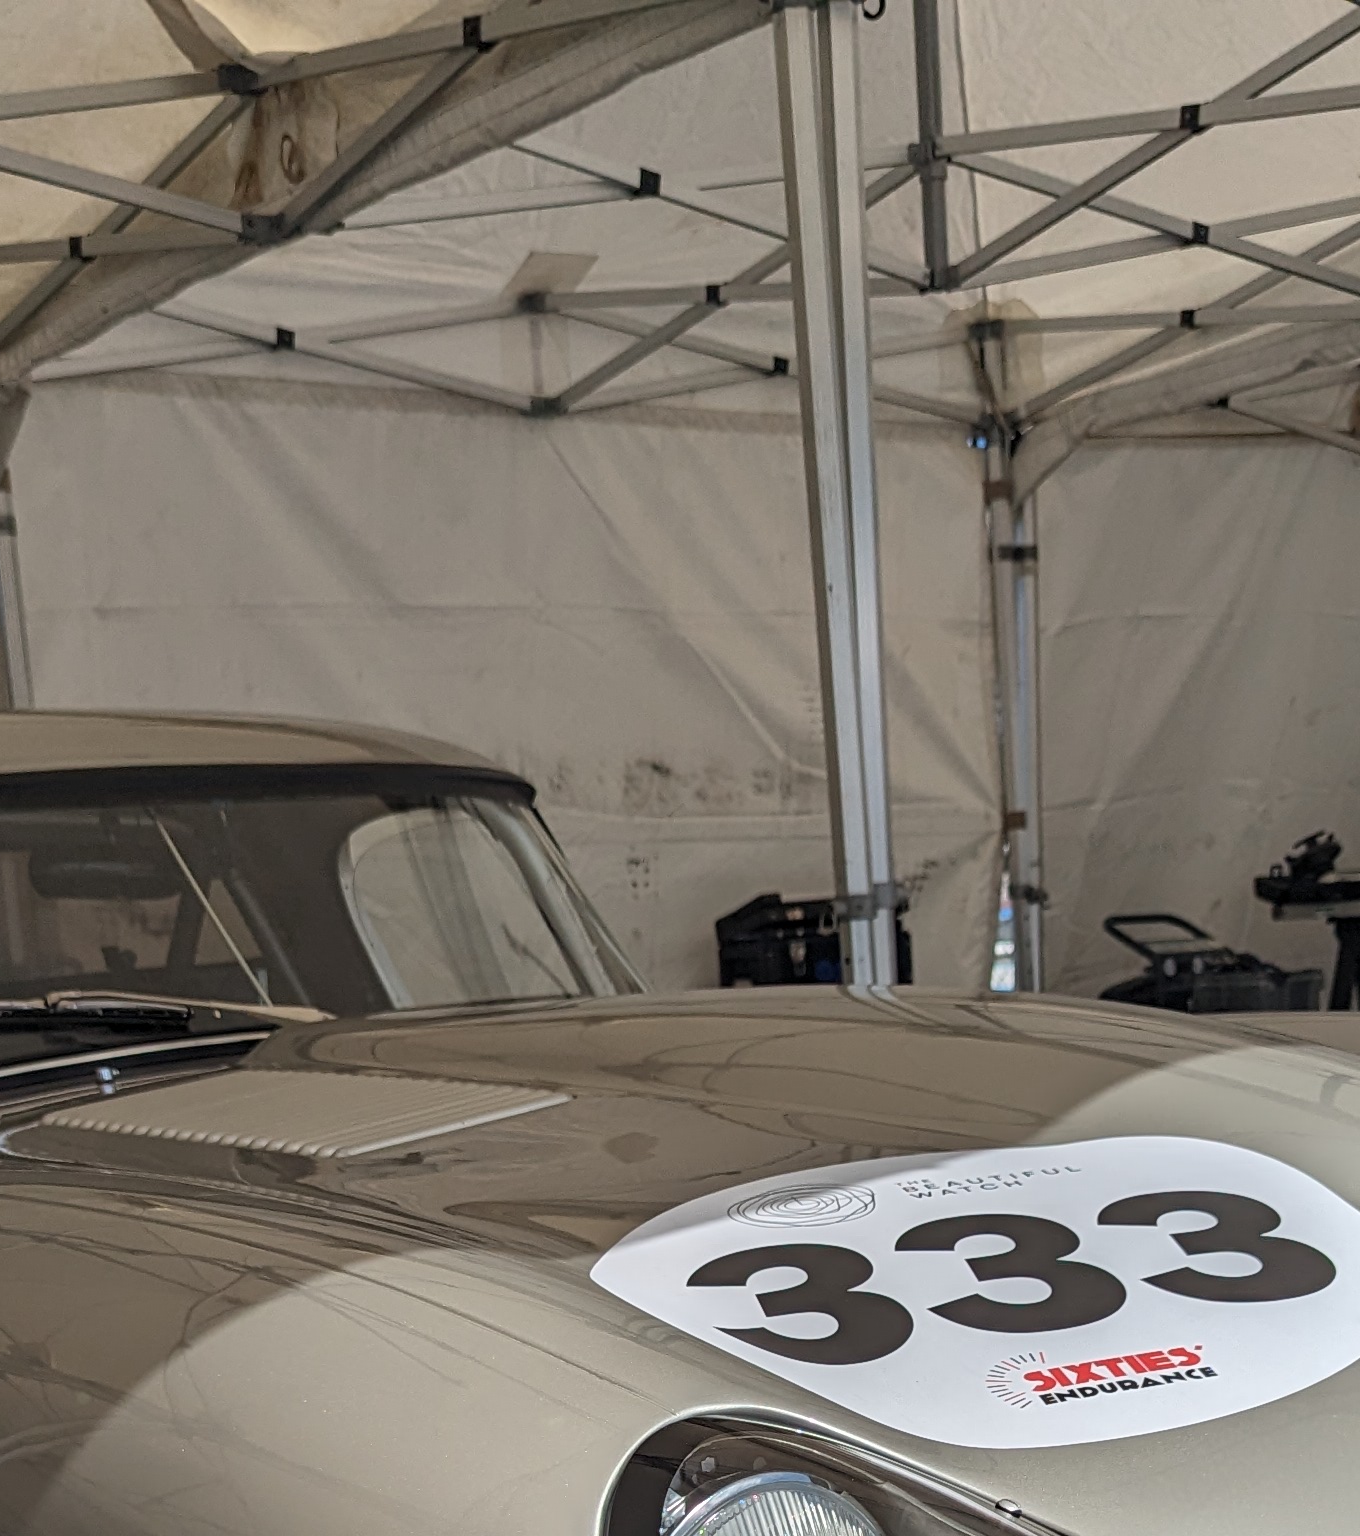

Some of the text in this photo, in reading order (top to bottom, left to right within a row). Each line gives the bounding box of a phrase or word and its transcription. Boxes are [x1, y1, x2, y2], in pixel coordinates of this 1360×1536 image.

[894, 1178, 931, 1187] THE
[902, 1165, 1082, 1193] BEAUTIFUL
[909, 1180, 1023, 1199] WATCH
[685, 1189, 1337, 1366] 333
[1023, 1346, 1202, 1392] SIXTIES
[1038, 1366, 1219, 1406] ENDURANCE
